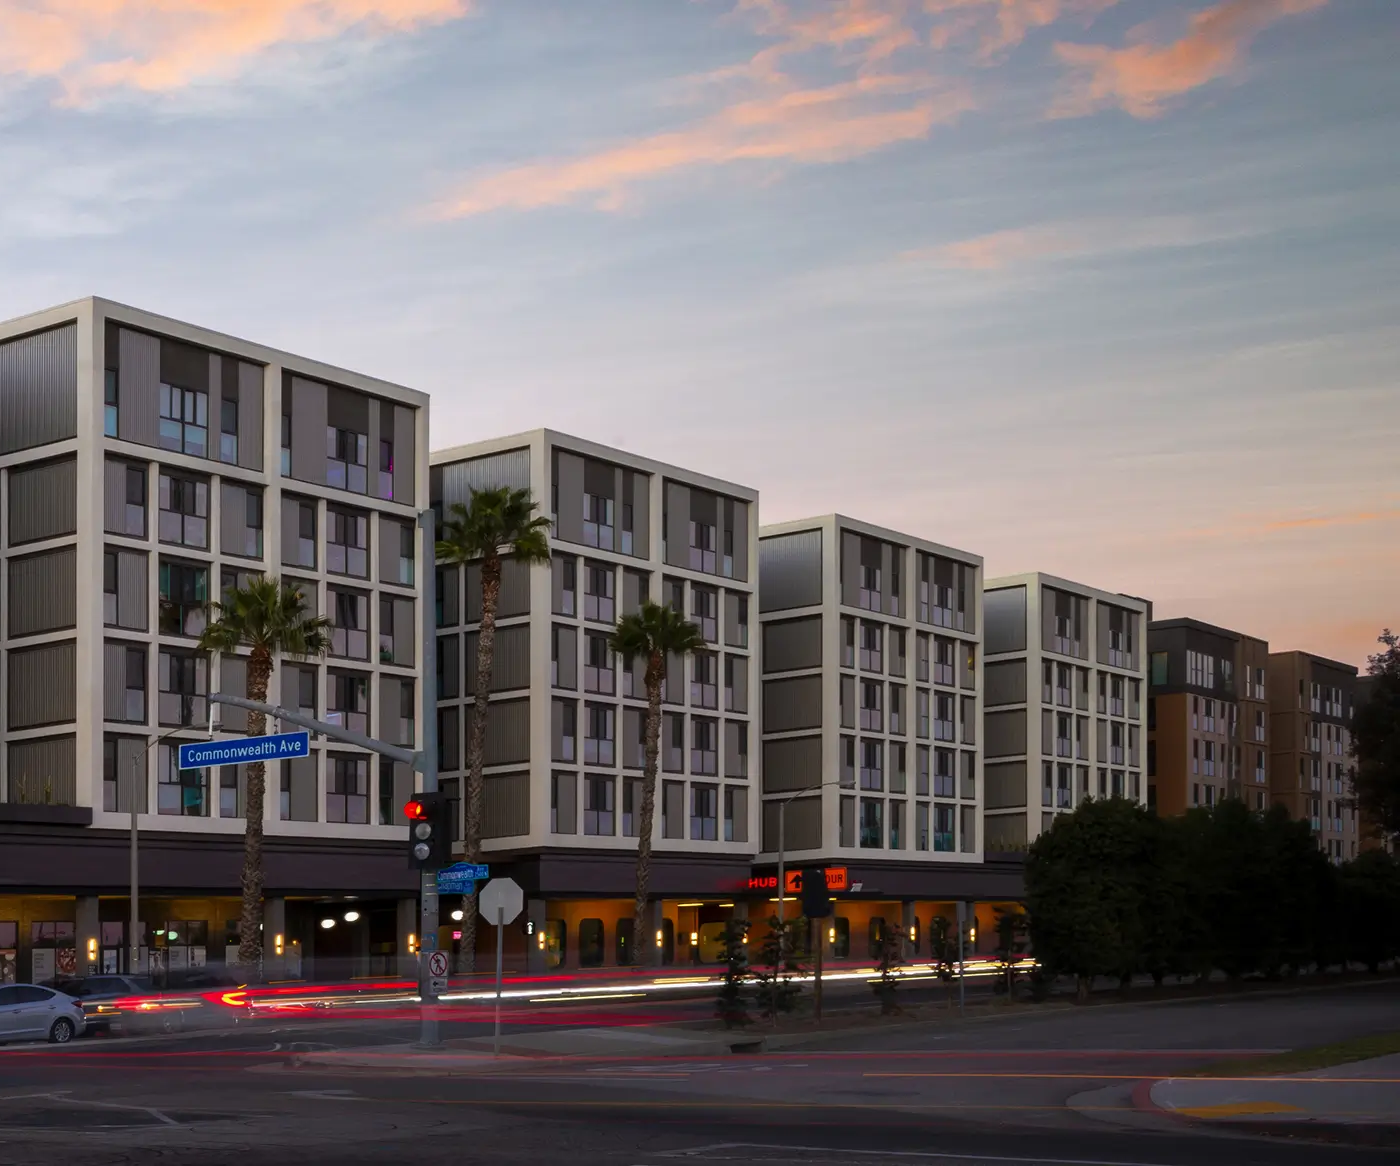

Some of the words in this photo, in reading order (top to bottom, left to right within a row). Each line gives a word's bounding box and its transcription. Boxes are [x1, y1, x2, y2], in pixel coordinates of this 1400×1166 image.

[188, 742, 276, 762] Commonwealth
[279, 739, 301, 753] Ave
[438, 868, 474, 880] Commonwealth
[748, 876, 777, 888] HUB
